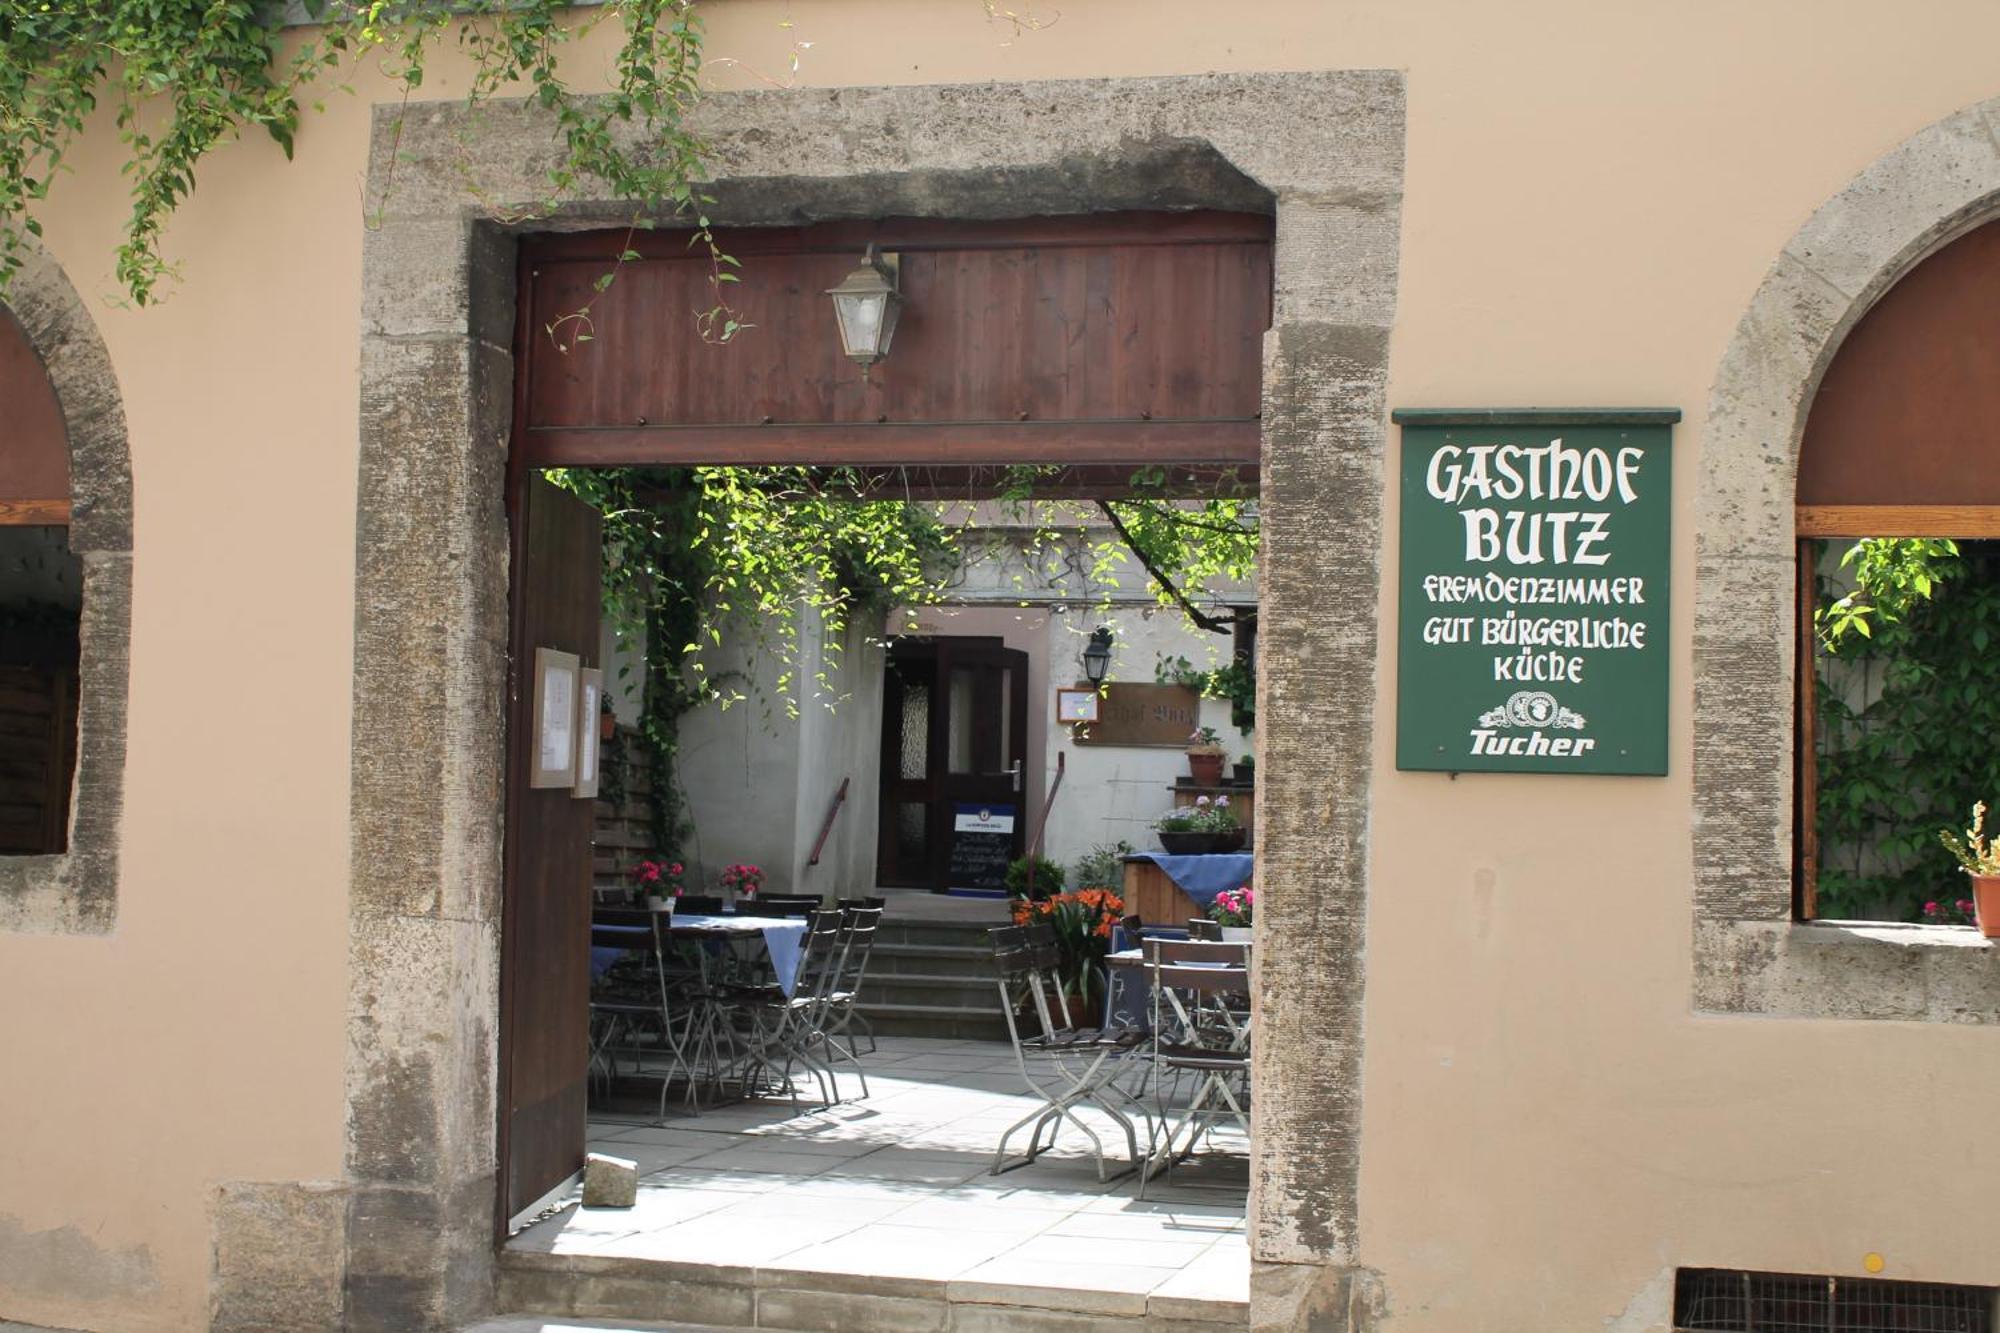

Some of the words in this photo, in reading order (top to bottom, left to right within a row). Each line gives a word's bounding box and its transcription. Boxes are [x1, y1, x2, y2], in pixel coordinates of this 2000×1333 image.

[1459, 508, 1612, 566] BUTZ
[1423, 572, 1645, 604] FREMDENZIMMER
[1423, 617, 1474, 644] GUT
[1470, 730, 1595, 757] Tucher
